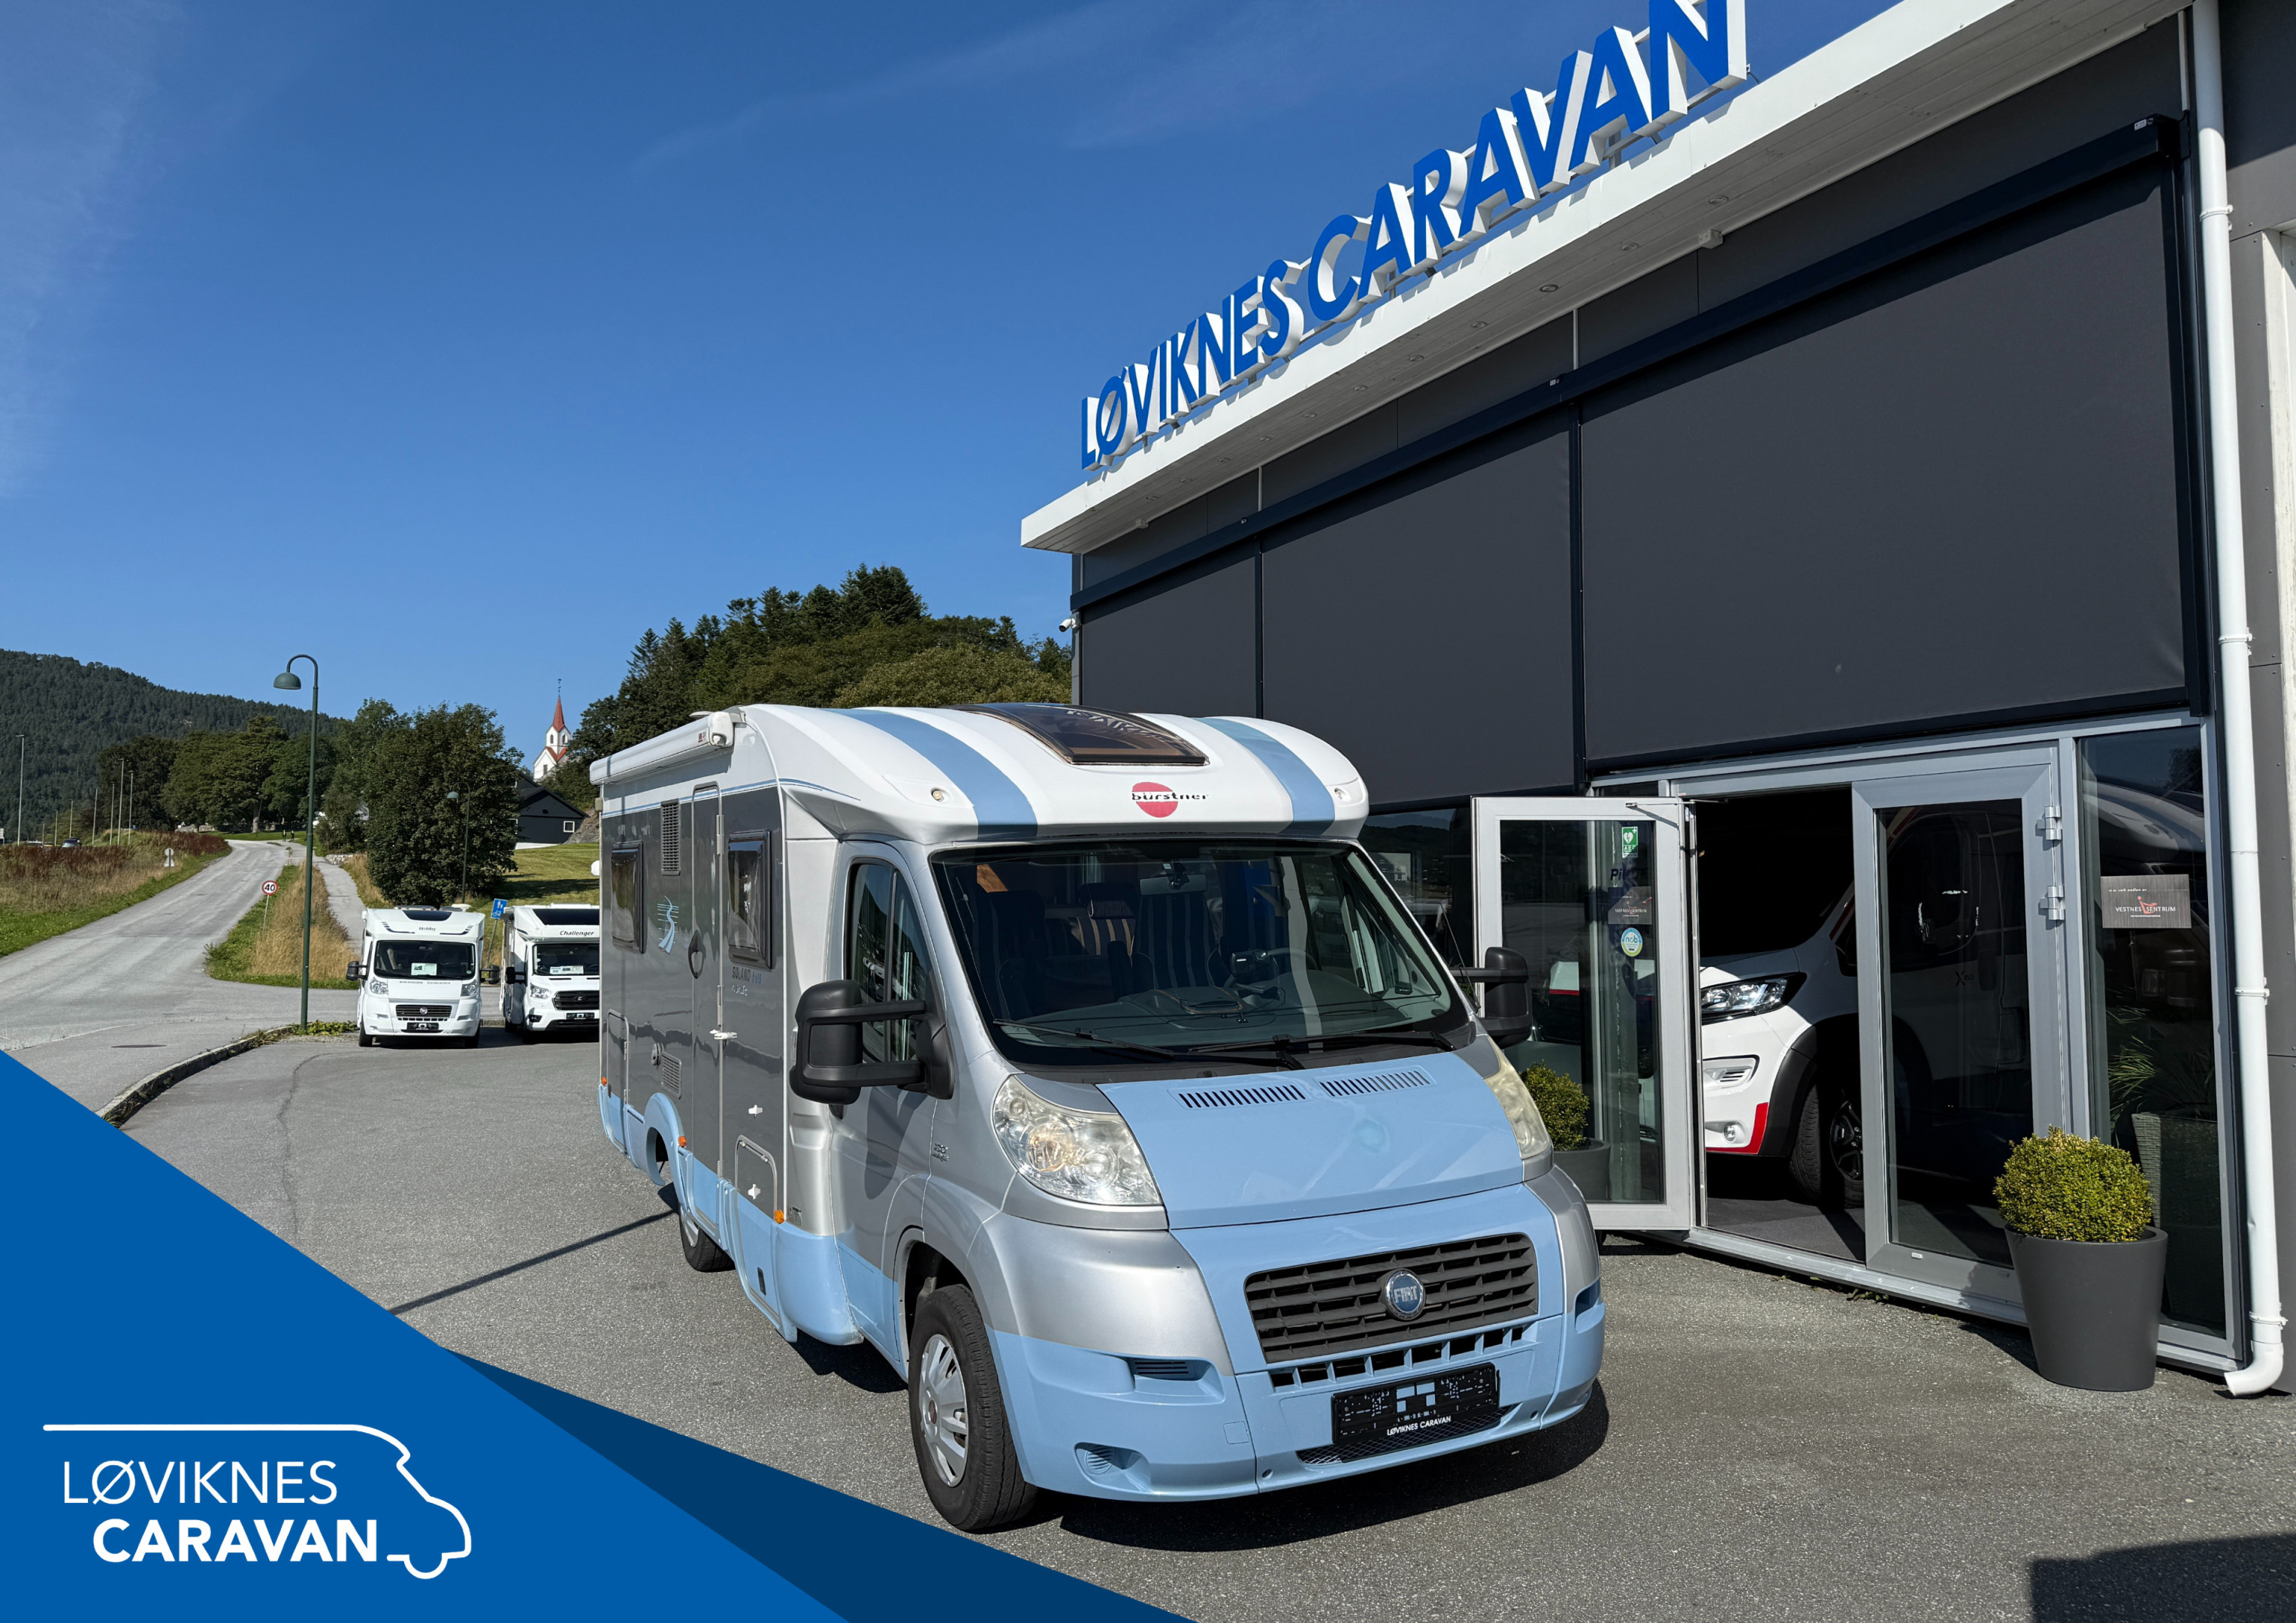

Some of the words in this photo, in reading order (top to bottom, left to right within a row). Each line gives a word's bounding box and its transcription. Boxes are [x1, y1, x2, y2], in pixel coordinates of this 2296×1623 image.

[1082, 260, 1303, 470] LØVIKNES
[1308, 0, 1746, 322] CARAVAN
[1394, 1286, 1418, 1303] FIAT
[1387, 1423, 1418, 1436] LØVIKNES
[1420, 1416, 1452, 1428] CARAVAN
